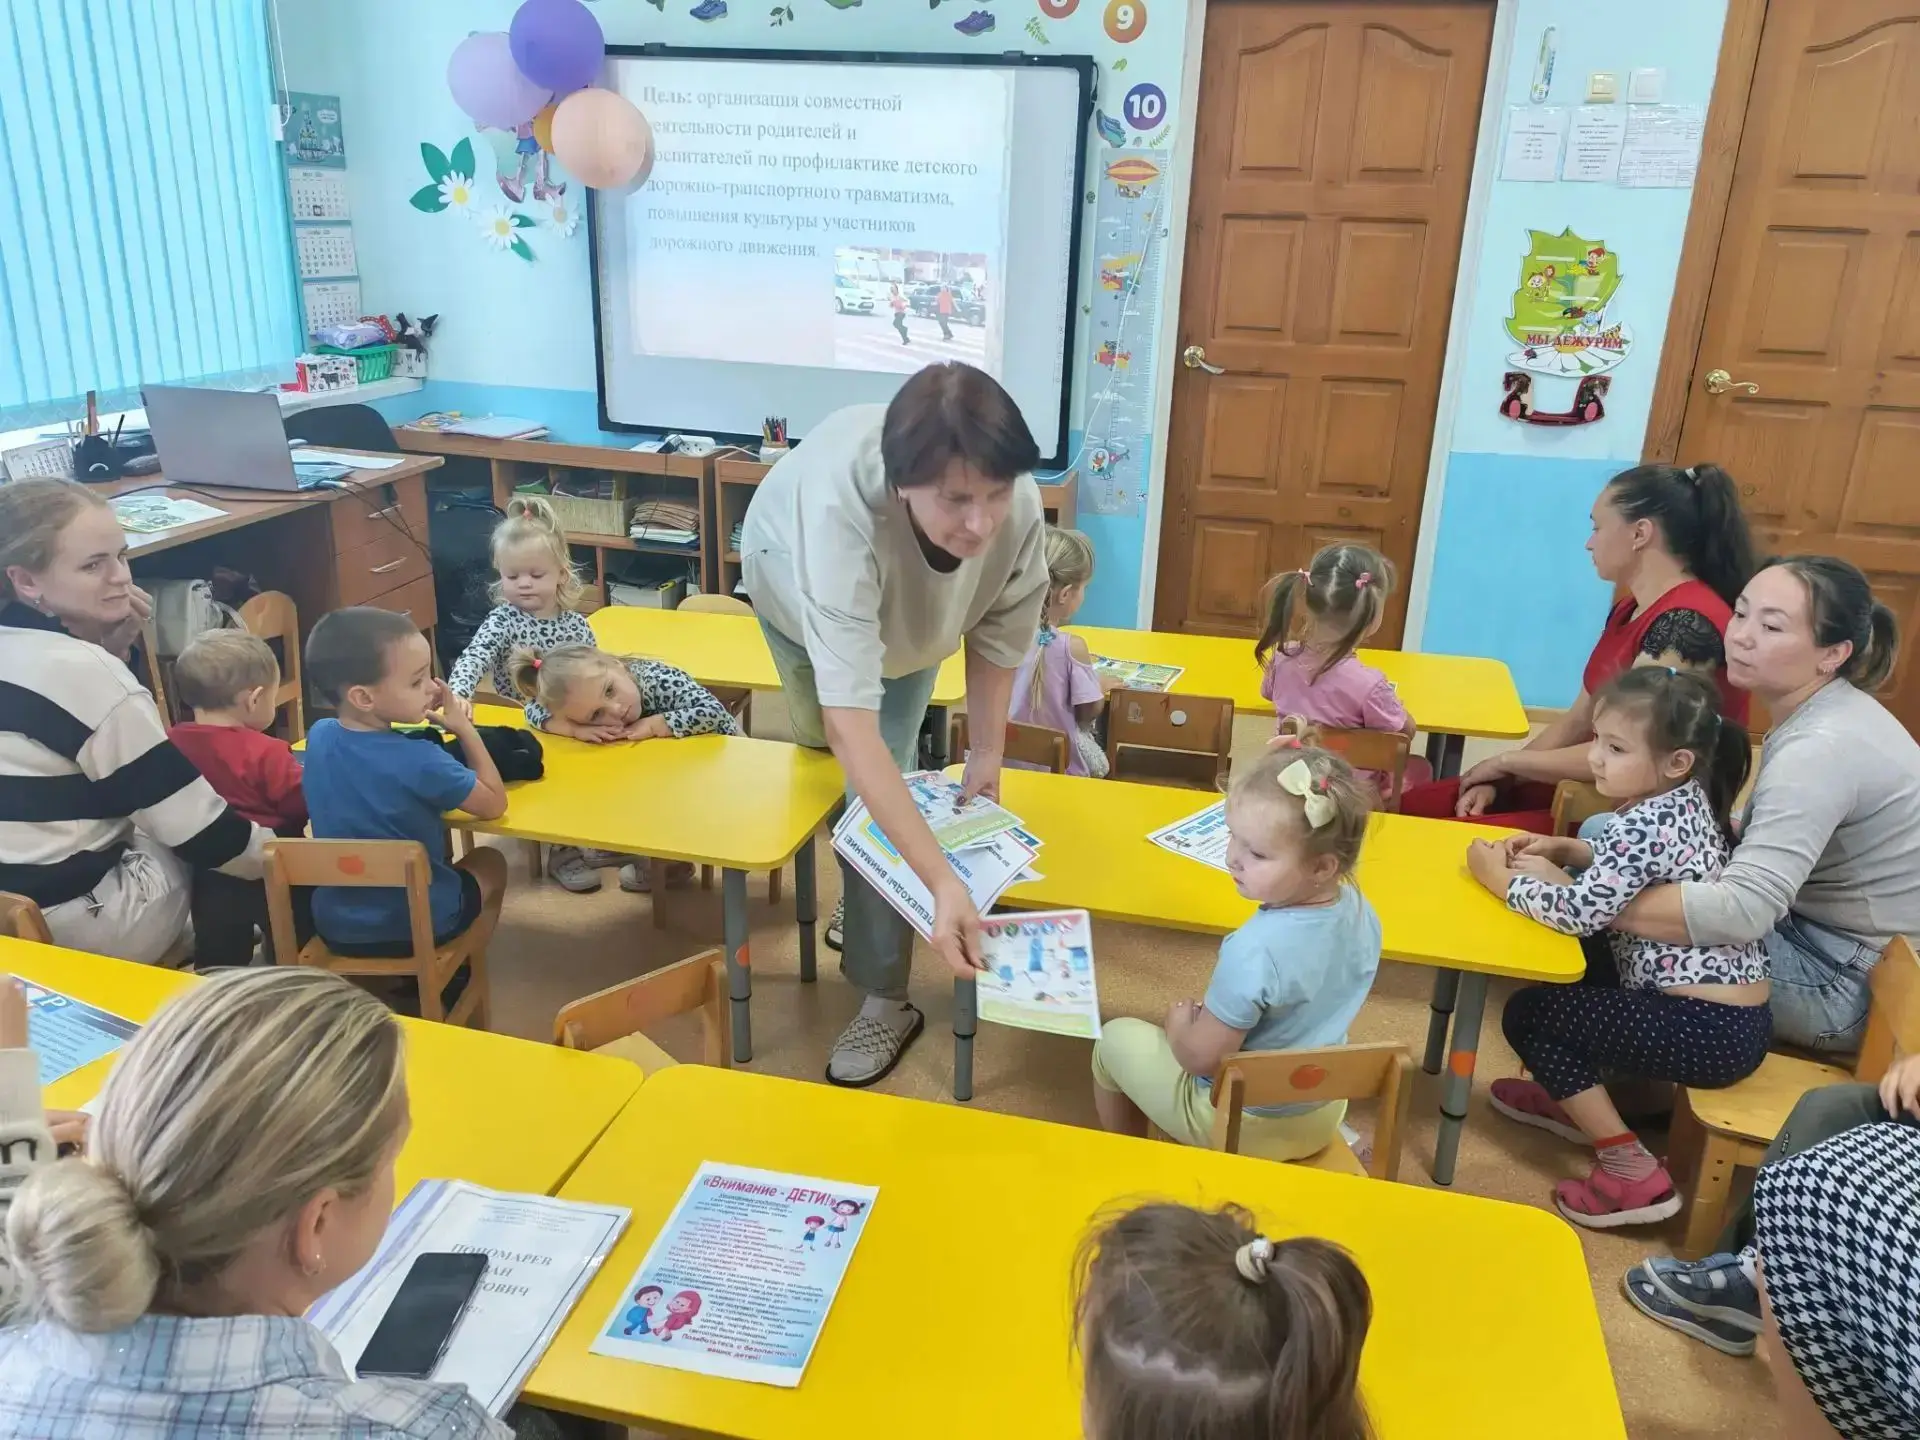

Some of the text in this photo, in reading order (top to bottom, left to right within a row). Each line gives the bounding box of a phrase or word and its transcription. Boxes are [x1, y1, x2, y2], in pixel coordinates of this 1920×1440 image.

[1116, 5, 1134, 29] 9
[643, 86, 901, 111] Цель: организация совместной
[1129, 94, 1161, 119] 10
[652, 121, 856, 140] еятельности родителей и
[652, 150, 978, 175] оспитателей по профилактике детского
[646, 179, 954, 206] дорожно-транспортного травматизма,
[648, 207, 916, 233] повышения культуры участников
[650, 235, 733, 253] дорожного
[1526, 334, 1624, 349] МЫ ДЕЖУРИМ
[843, 834, 888, 879] ВНИМАНИЕ!
[942, 851, 973, 879] ПЕРЕХО
[703, 1175, 778, 1198] «Внимание
[785, 1187, 838, 1207] ДЕТИ!»
